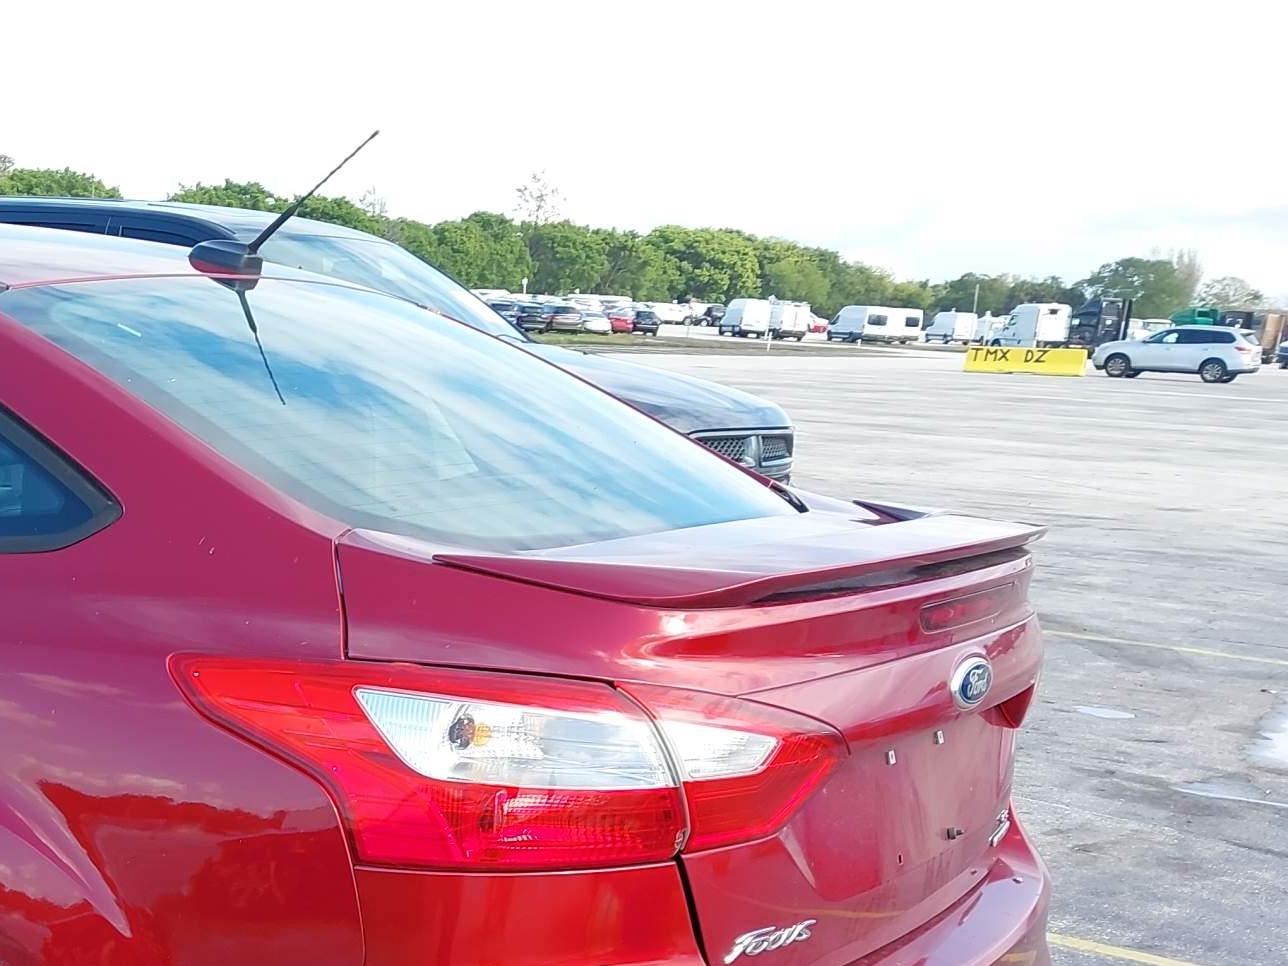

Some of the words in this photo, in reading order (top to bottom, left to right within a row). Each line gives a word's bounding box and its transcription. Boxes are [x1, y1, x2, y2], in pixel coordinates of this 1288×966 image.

[971, 347, 1010, 362] TMX
[1024, 349, 1050, 363] DZ
[967, 668, 989, 698] Ford
[723, 918, 817, 965] Focus
